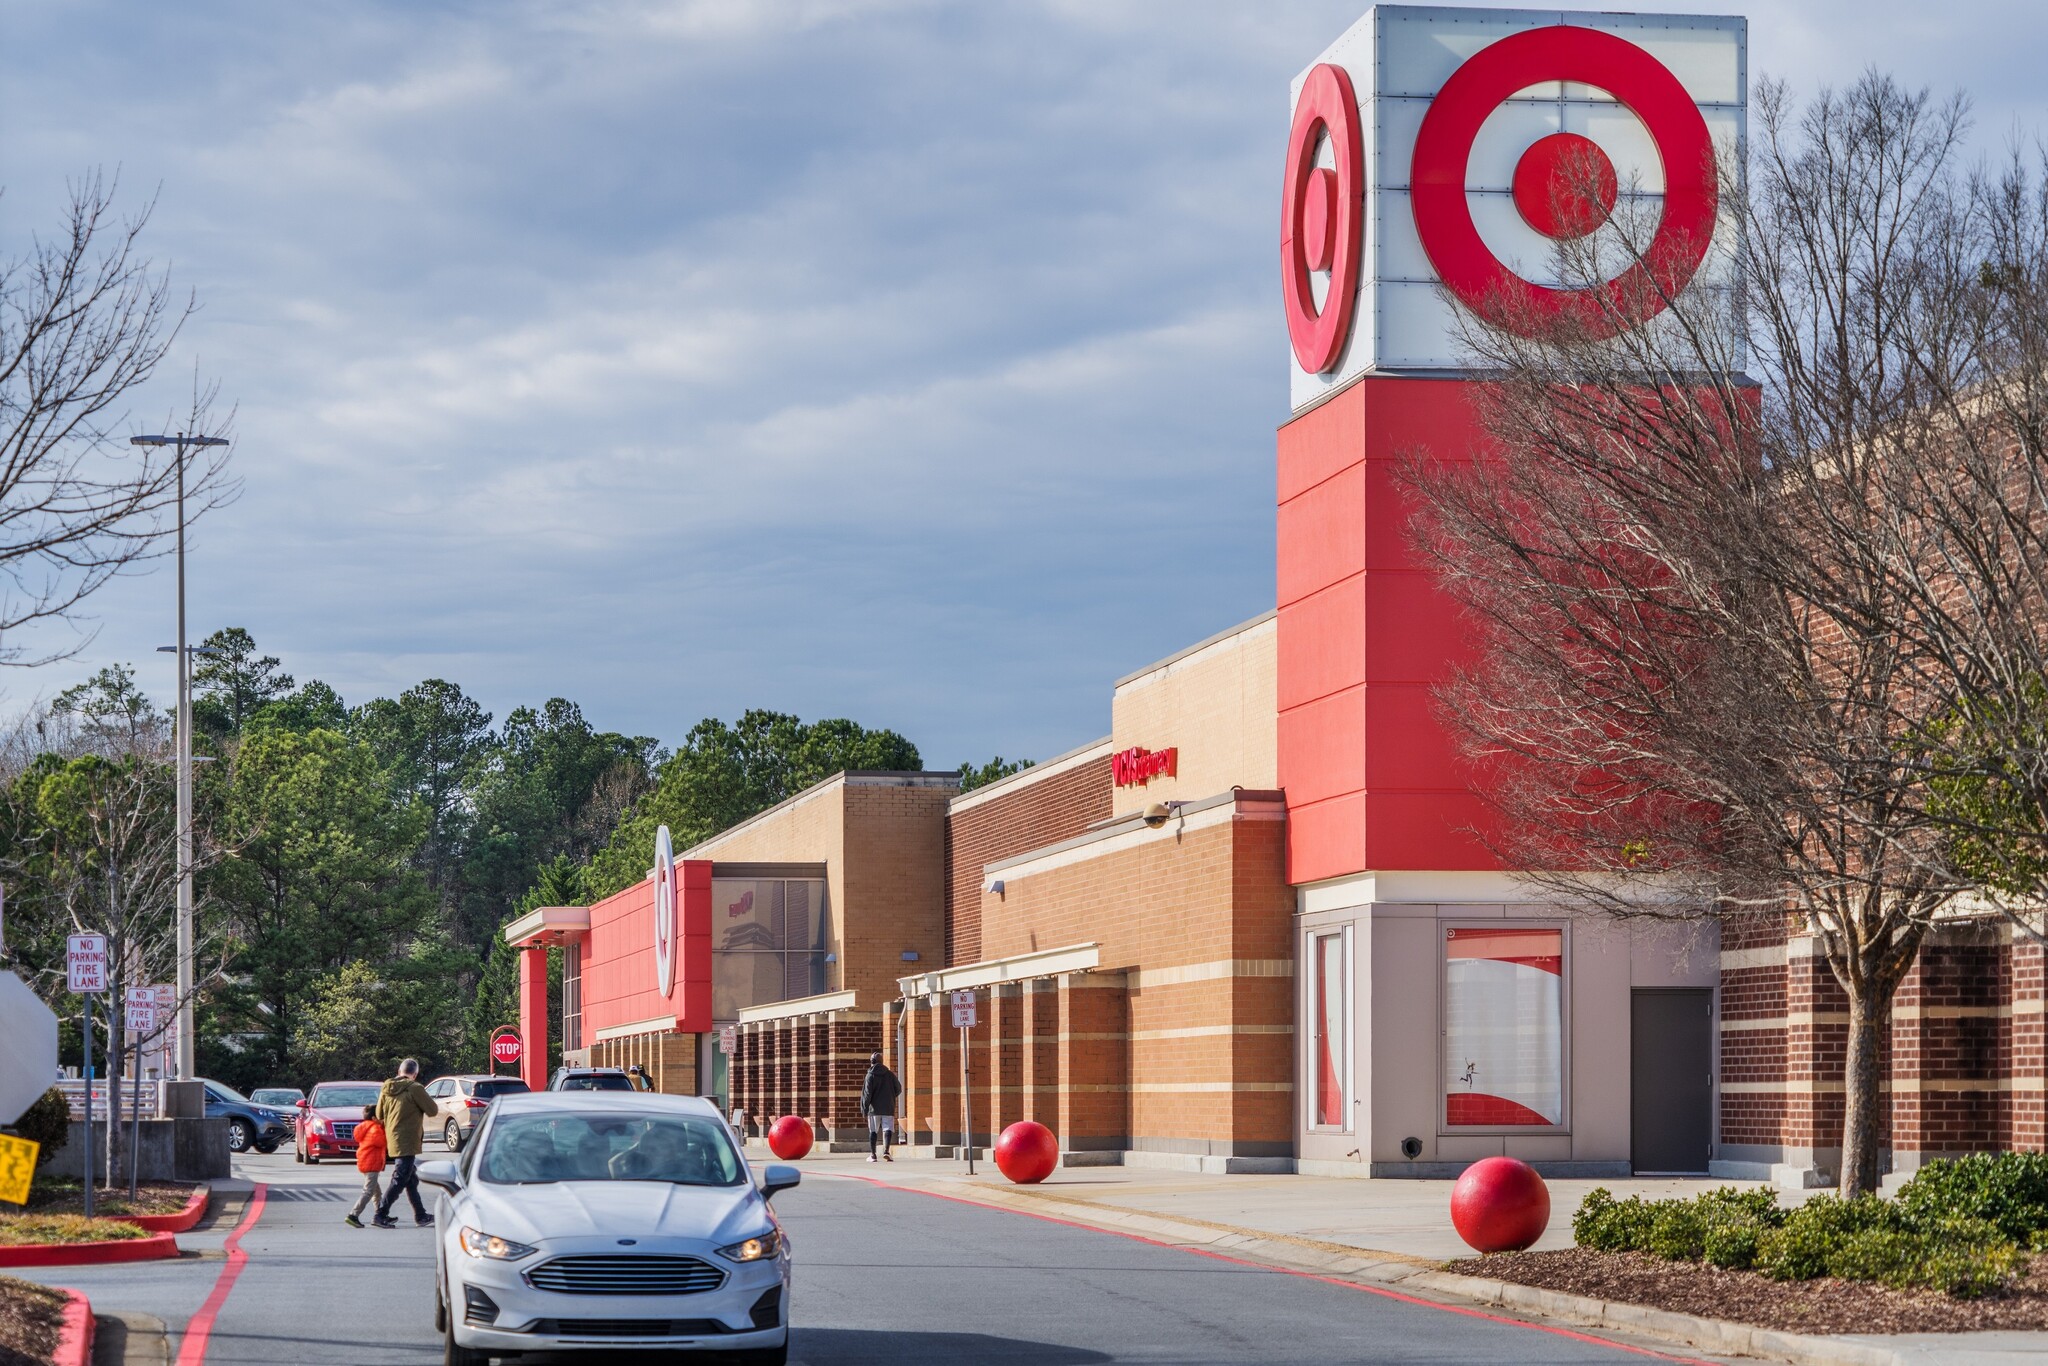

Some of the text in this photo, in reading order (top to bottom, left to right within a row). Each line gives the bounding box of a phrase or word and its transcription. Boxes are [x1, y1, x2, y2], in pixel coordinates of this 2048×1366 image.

[80, 940, 93, 951] NO
[70, 952, 104, 963] PARKING
[76, 965, 98, 975] FIRE
[74, 977, 100, 987] LANE
[136, 991, 146, 1000] NO
[128, 1001, 154, 1009] PARKING
[131, 1010, 149, 1019] FIRE
[129, 1020, 150, 1028] LANE
[495, 1043, 519, 1055] STOP
